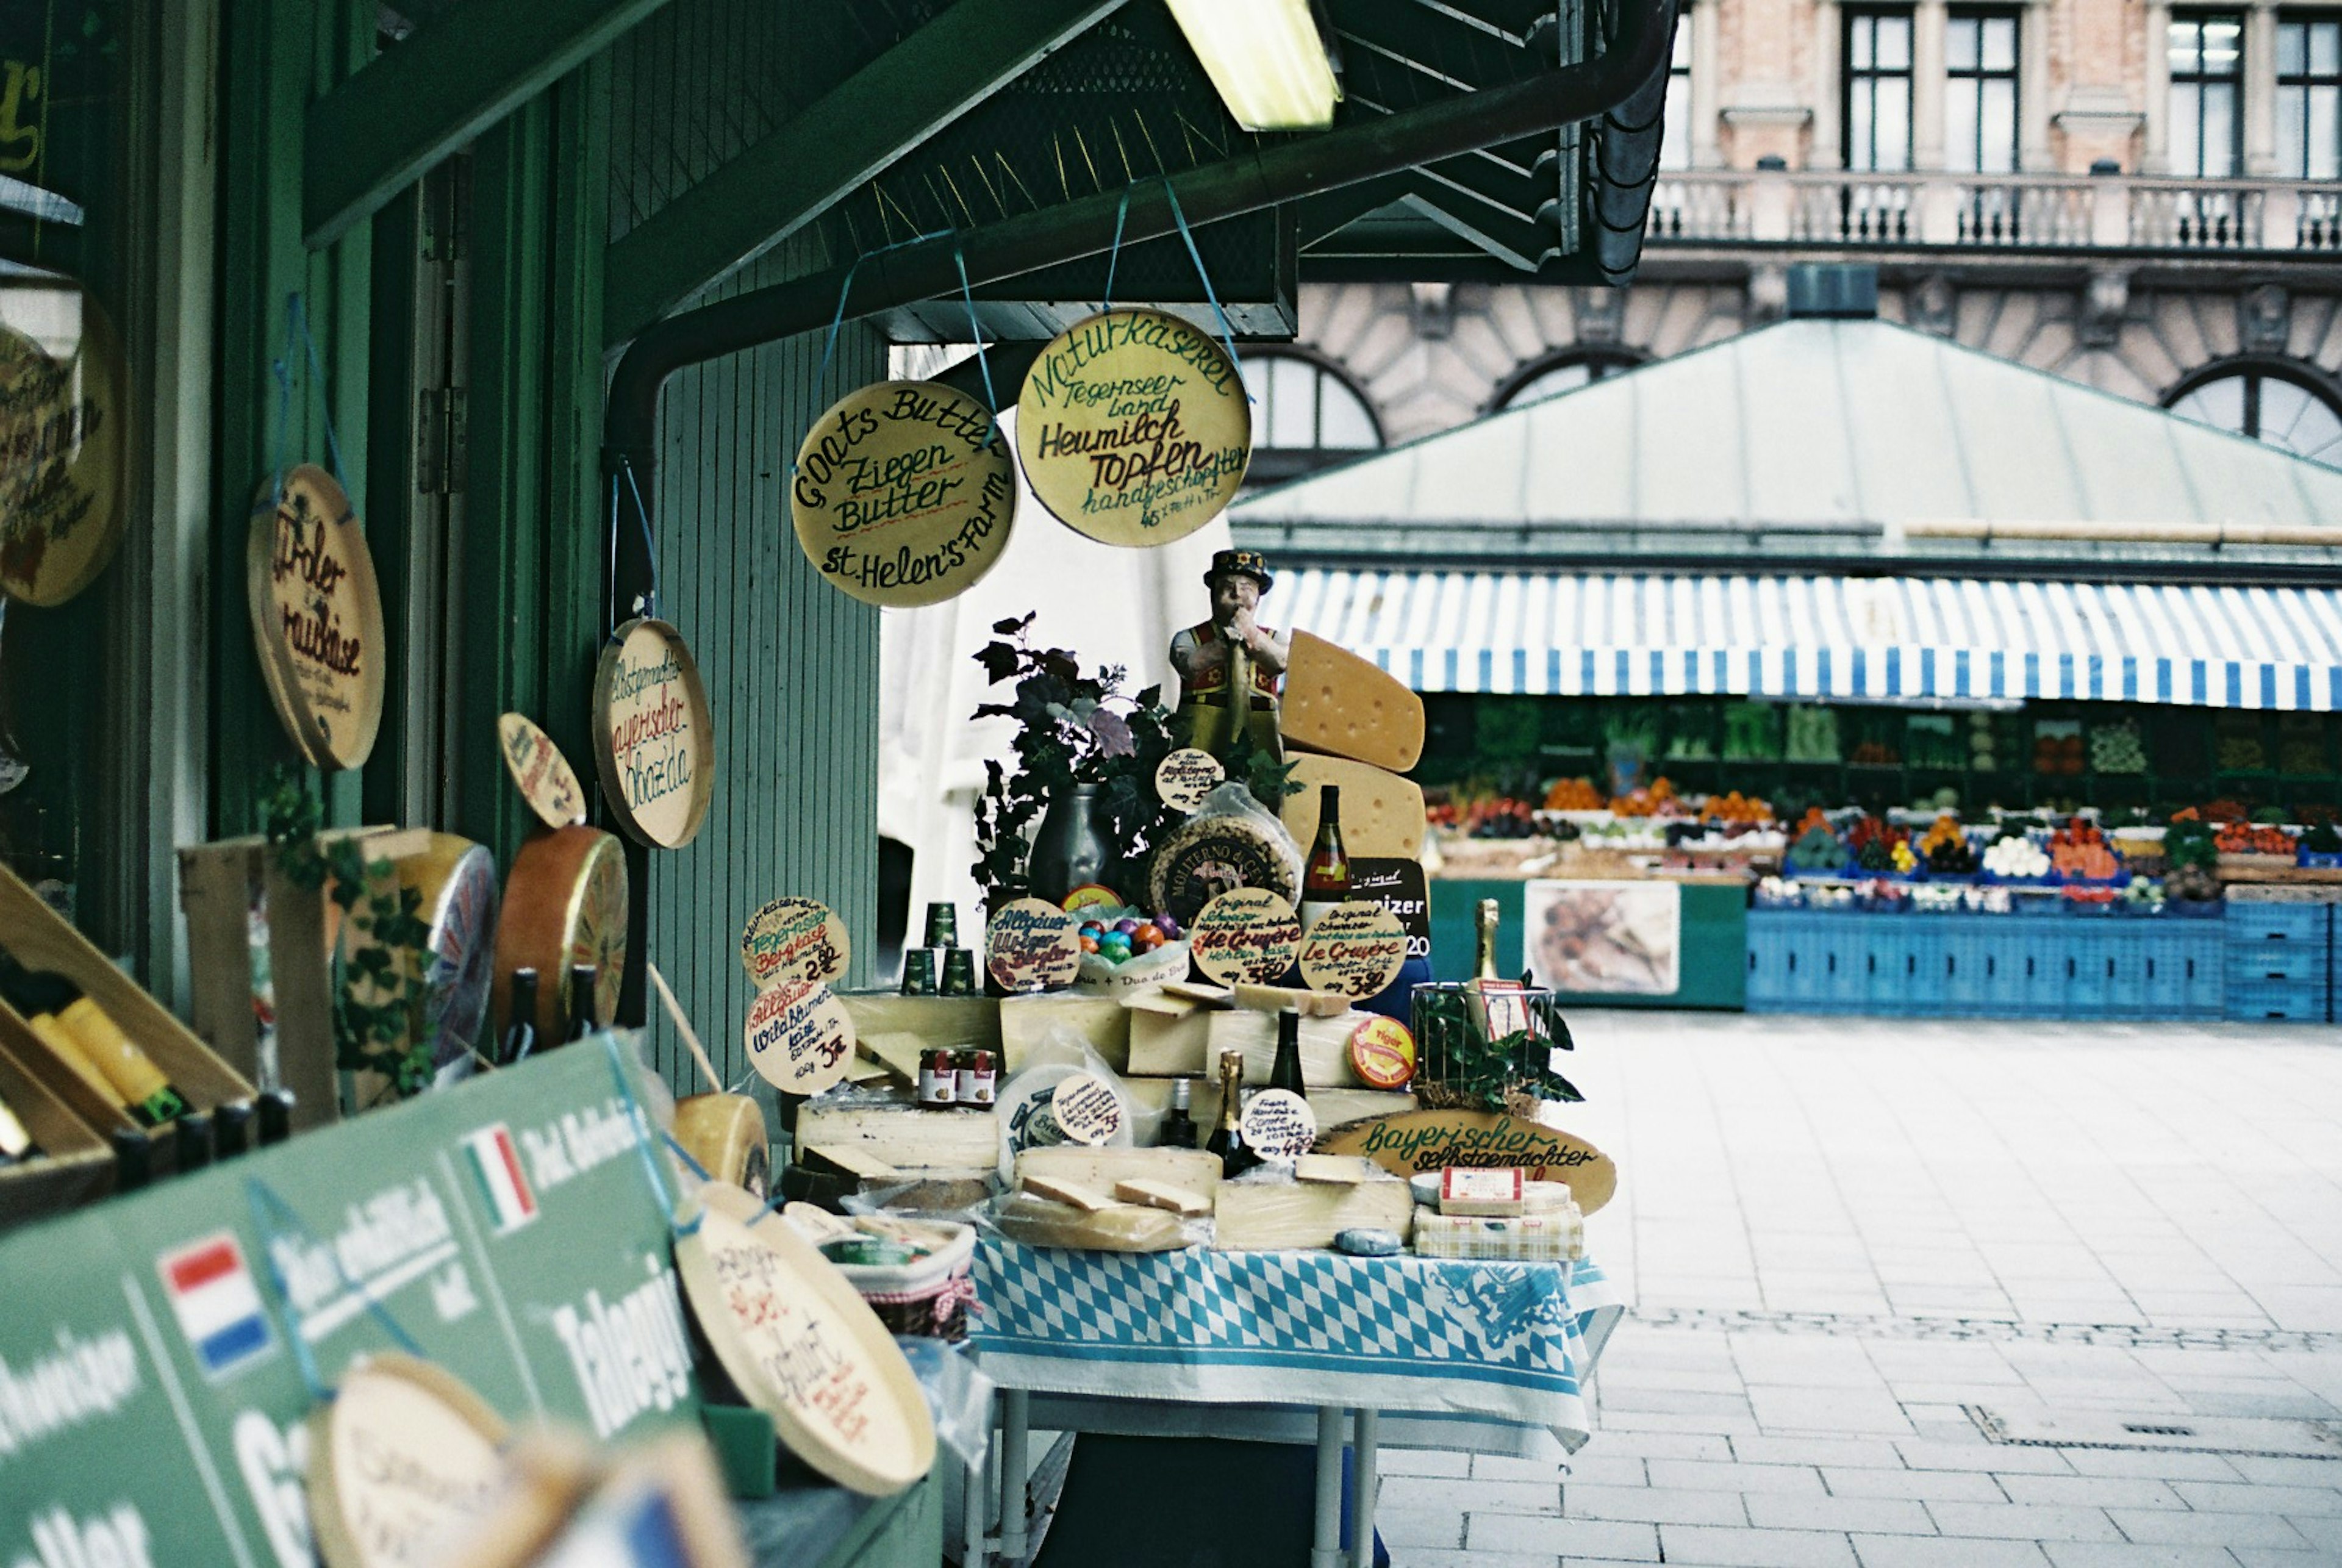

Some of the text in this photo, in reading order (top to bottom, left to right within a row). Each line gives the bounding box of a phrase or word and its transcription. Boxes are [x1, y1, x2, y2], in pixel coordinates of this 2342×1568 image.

[1063, 374, 1187, 409] Tegernseer
[1108, 393, 1172, 418] Land
[1039, 398, 1186, 459] Heumilch
[840, 445, 955, 494] Ziegen
[1089, 442, 1214, 490] Topfen
[832, 477, 965, 532] Butter
[613, 683, 685, 768] ayerischer
[1303, 940, 1325, 961] Le
